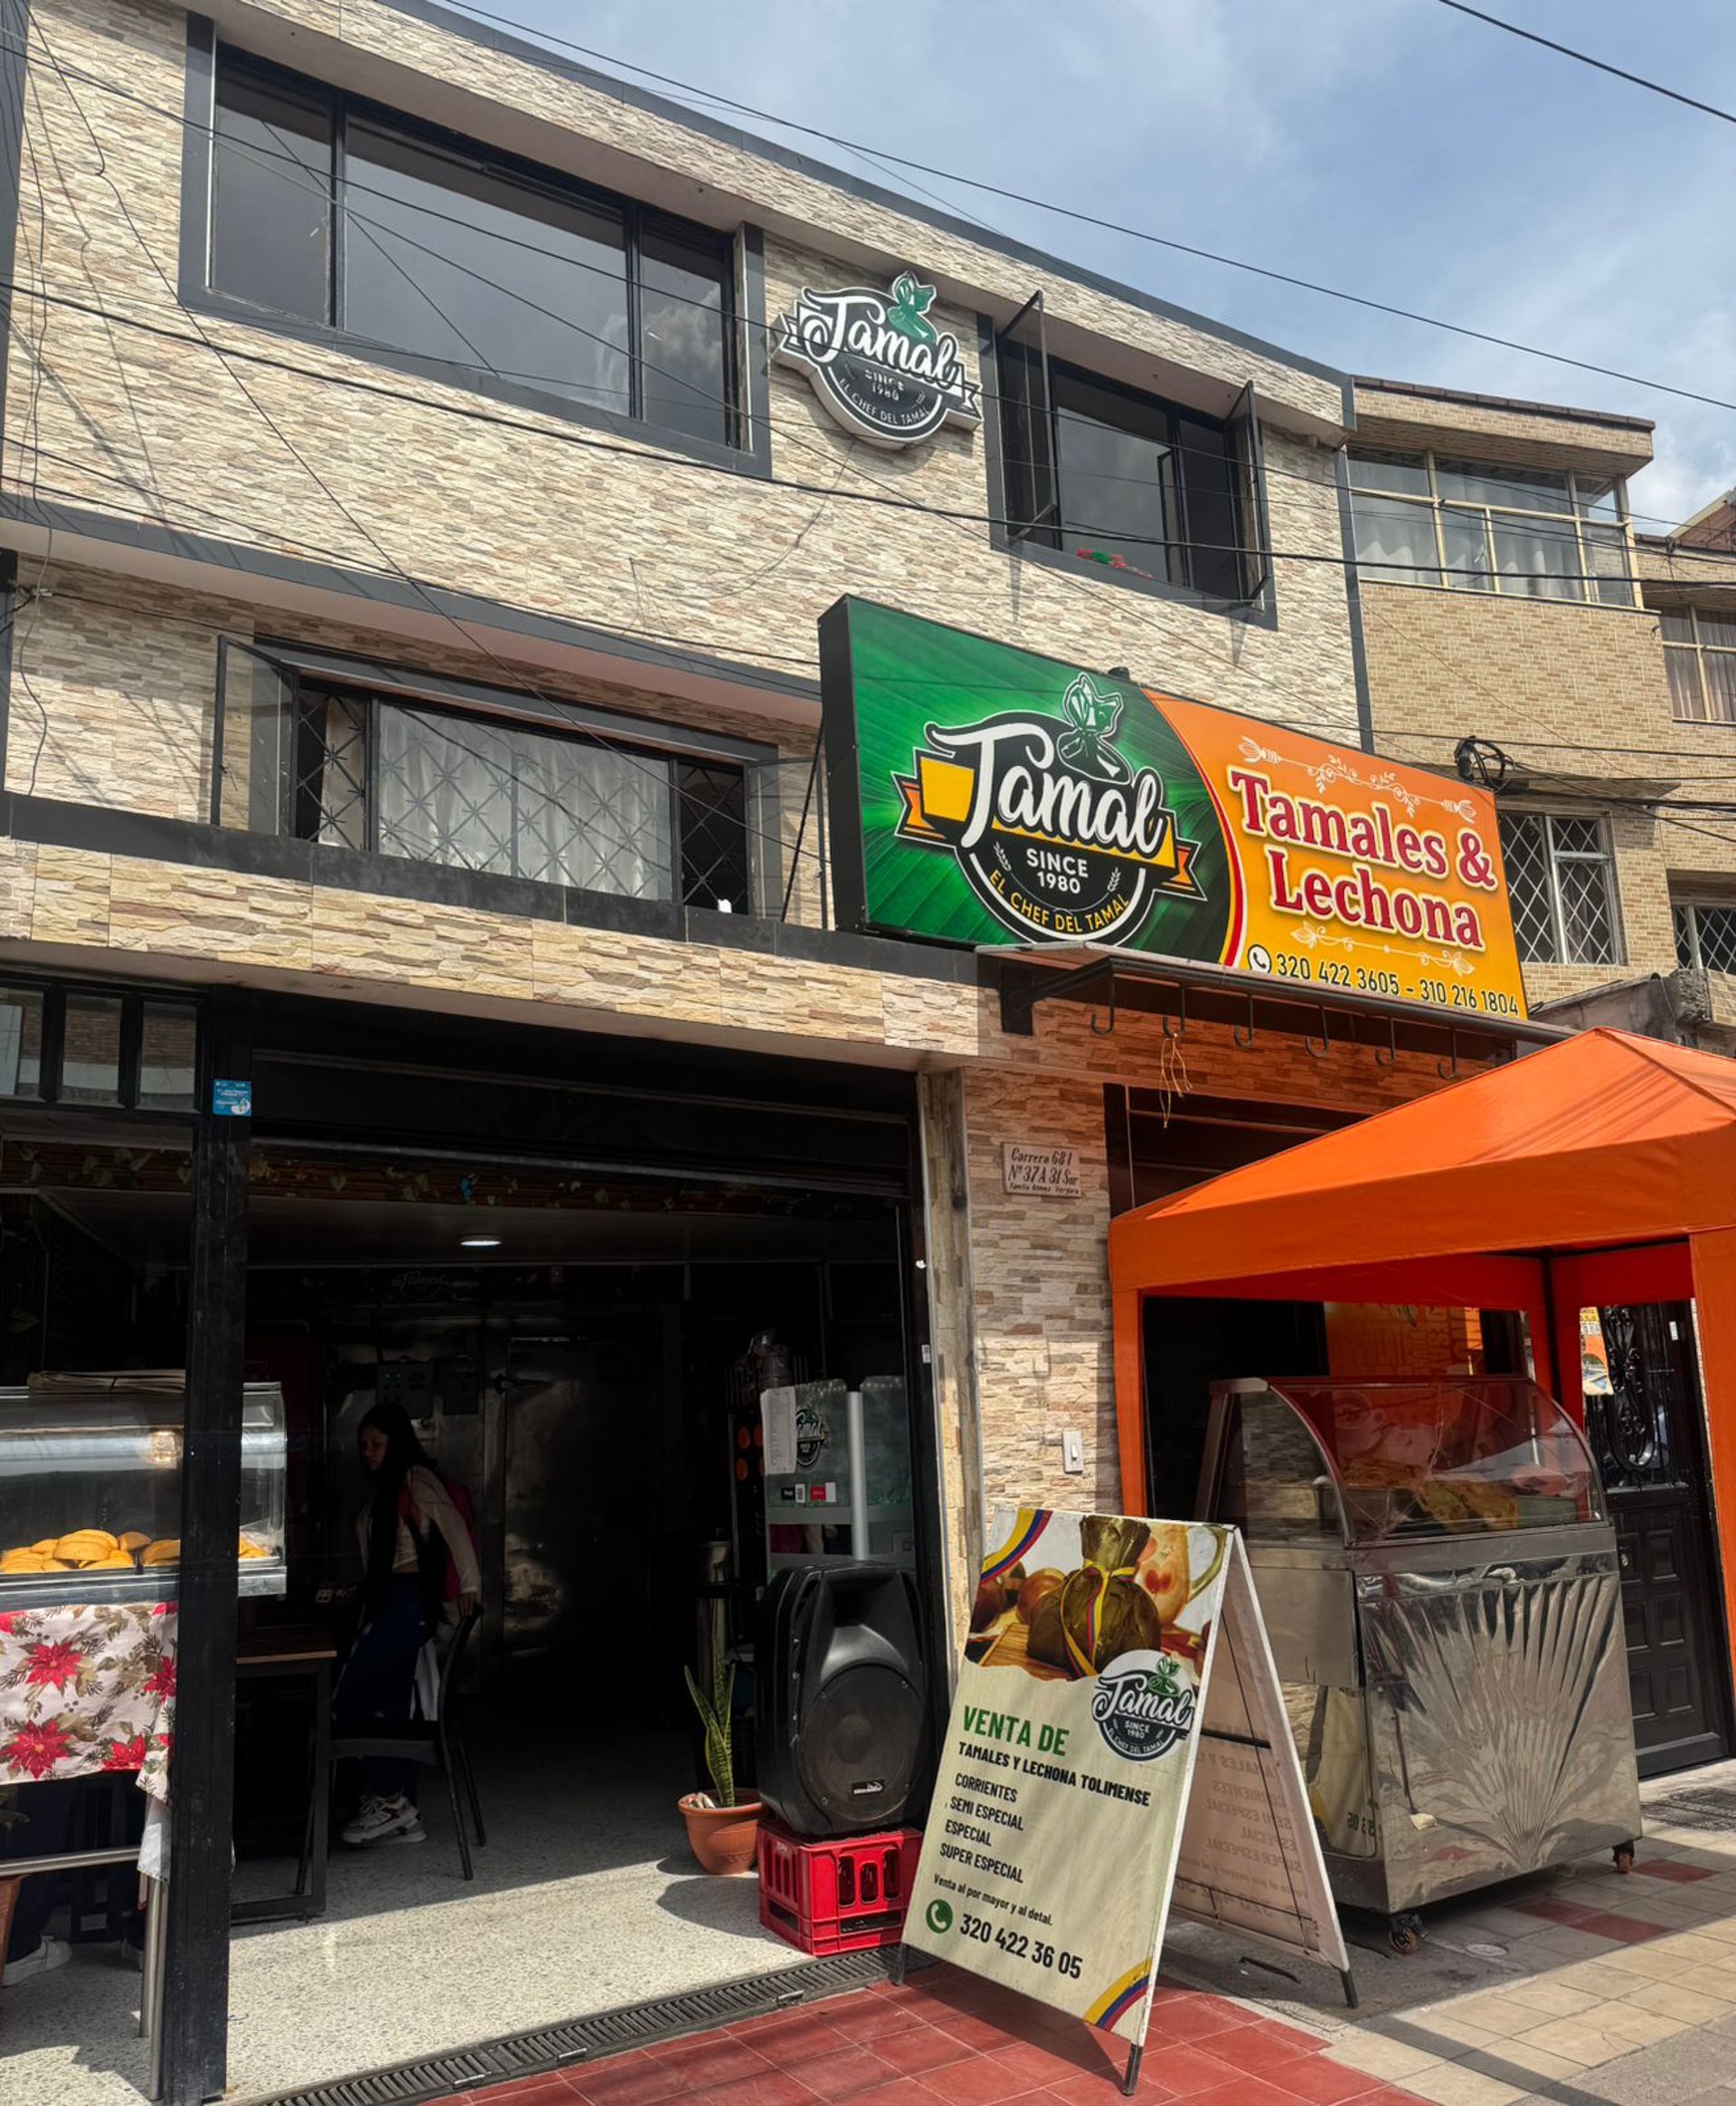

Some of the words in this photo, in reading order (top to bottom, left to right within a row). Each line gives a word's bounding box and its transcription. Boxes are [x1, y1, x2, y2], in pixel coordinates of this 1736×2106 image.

[804, 289, 958, 384] Tamal
[839, 378, 851, 392] EL
[852, 392, 876, 415] CHEF
[880, 410, 898, 424] DEL
[901, 406, 930, 424] TAMAL
[931, 722, 1165, 854] Tamal
[1230, 770, 1448, 876] Tamales
[1458, 832, 1496, 888] &
[1026, 847, 1089, 878] SINCE
[1037, 872, 1081, 894] 1980
[989, 869, 1005, 894] EL
[1010, 892, 1050, 926] CHEF
[1054, 914, 1083, 932] DEL
[1085, 893, 1129, 931] TAMAL
[1267, 849, 1484, 949] Lechona
[1277, 953, 1310, 980] 320
[1318, 960, 1351, 987] 422
[1357, 968, 1399, 996] 3605
[1420, 979, 1446, 1004] 310
[1452, 985, 1477, 1009] 216
[1481, 990, 1519, 1015] 1804
[1092, 1673, 1191, 1726] Tamal
[963, 1705, 1031, 1747] VENTA
[1037, 1724, 1070, 1756] DE
[1114, 1736, 1128, 1751] CHEF
[1128, 1744, 1141, 1754] DEL
[1143, 1738, 1165, 1753] TAMAL
[1124, 1719, 1150, 1733] SINCE
[1127, 1728, 1146, 1739] 1980
[955, 1772, 1018, 1802] CORRIENTES
[958, 1742, 1010, 1768] TAMALES
[1013, 1755, 1022, 1771] Y
[1023, 1759, 1077, 1787] LECHONA
[1080, 1773, 1151, 1807] TOLIMENSE
[945, 1819, 992, 1846] ESPECIAL
[949, 1796, 974, 1815] SEMI
[976, 1803, 1024, 1831] ESPECIAL
[939, 1842, 973, 1865] SUPER
[974, 1854, 1024, 1884] ESPECIAL
[933, 1873, 957, 1891] Venta
[957, 1883, 965, 1894] al
[966, 1887, 982, 1903] por
[982, 1893, 1010, 1910] mayor
[1010, 1903, 1017, 1915] y
[1017, 1904, 1026, 1916] al
[1028, 1907, 1052, 1926] detal.
[959, 1913, 992, 1943] 320
[995, 1928, 1029, 1959] 422
[1032, 1941, 1055, 1969] 36
[1058, 1950, 1083, 1979] 05
